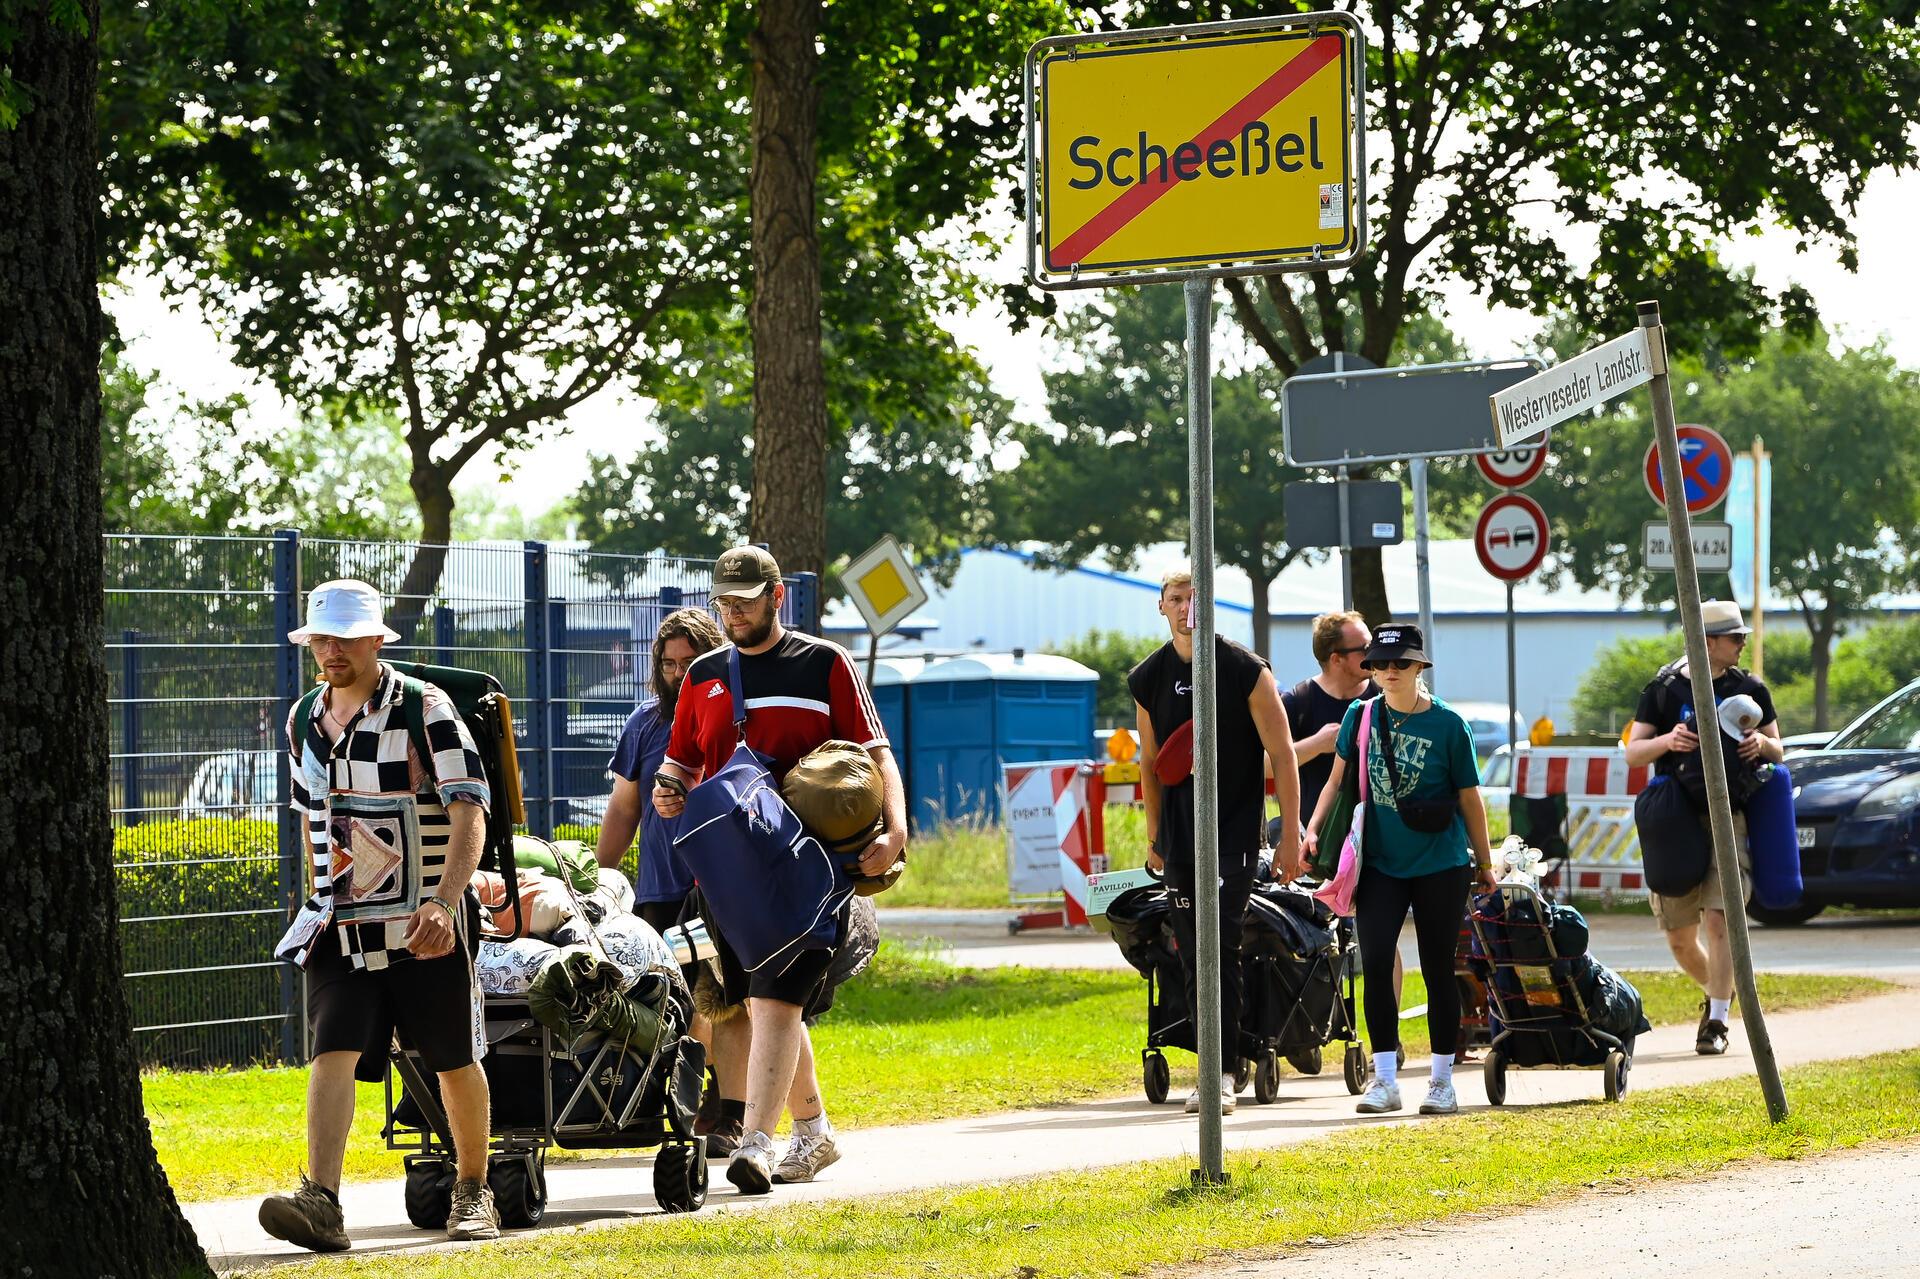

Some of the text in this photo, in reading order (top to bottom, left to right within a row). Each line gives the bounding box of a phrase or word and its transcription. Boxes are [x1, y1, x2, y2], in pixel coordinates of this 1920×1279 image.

[1067, 116, 1324, 190] Scheeßel
[1500, 348, 1645, 435] Westerveseder Landstr.
[753, 818, 774, 835] pepsi
[1093, 881, 1135, 894] PAVILLON
[1174, 897, 1190, 909] LG
[474, 1009, 483, 1047] adidas
